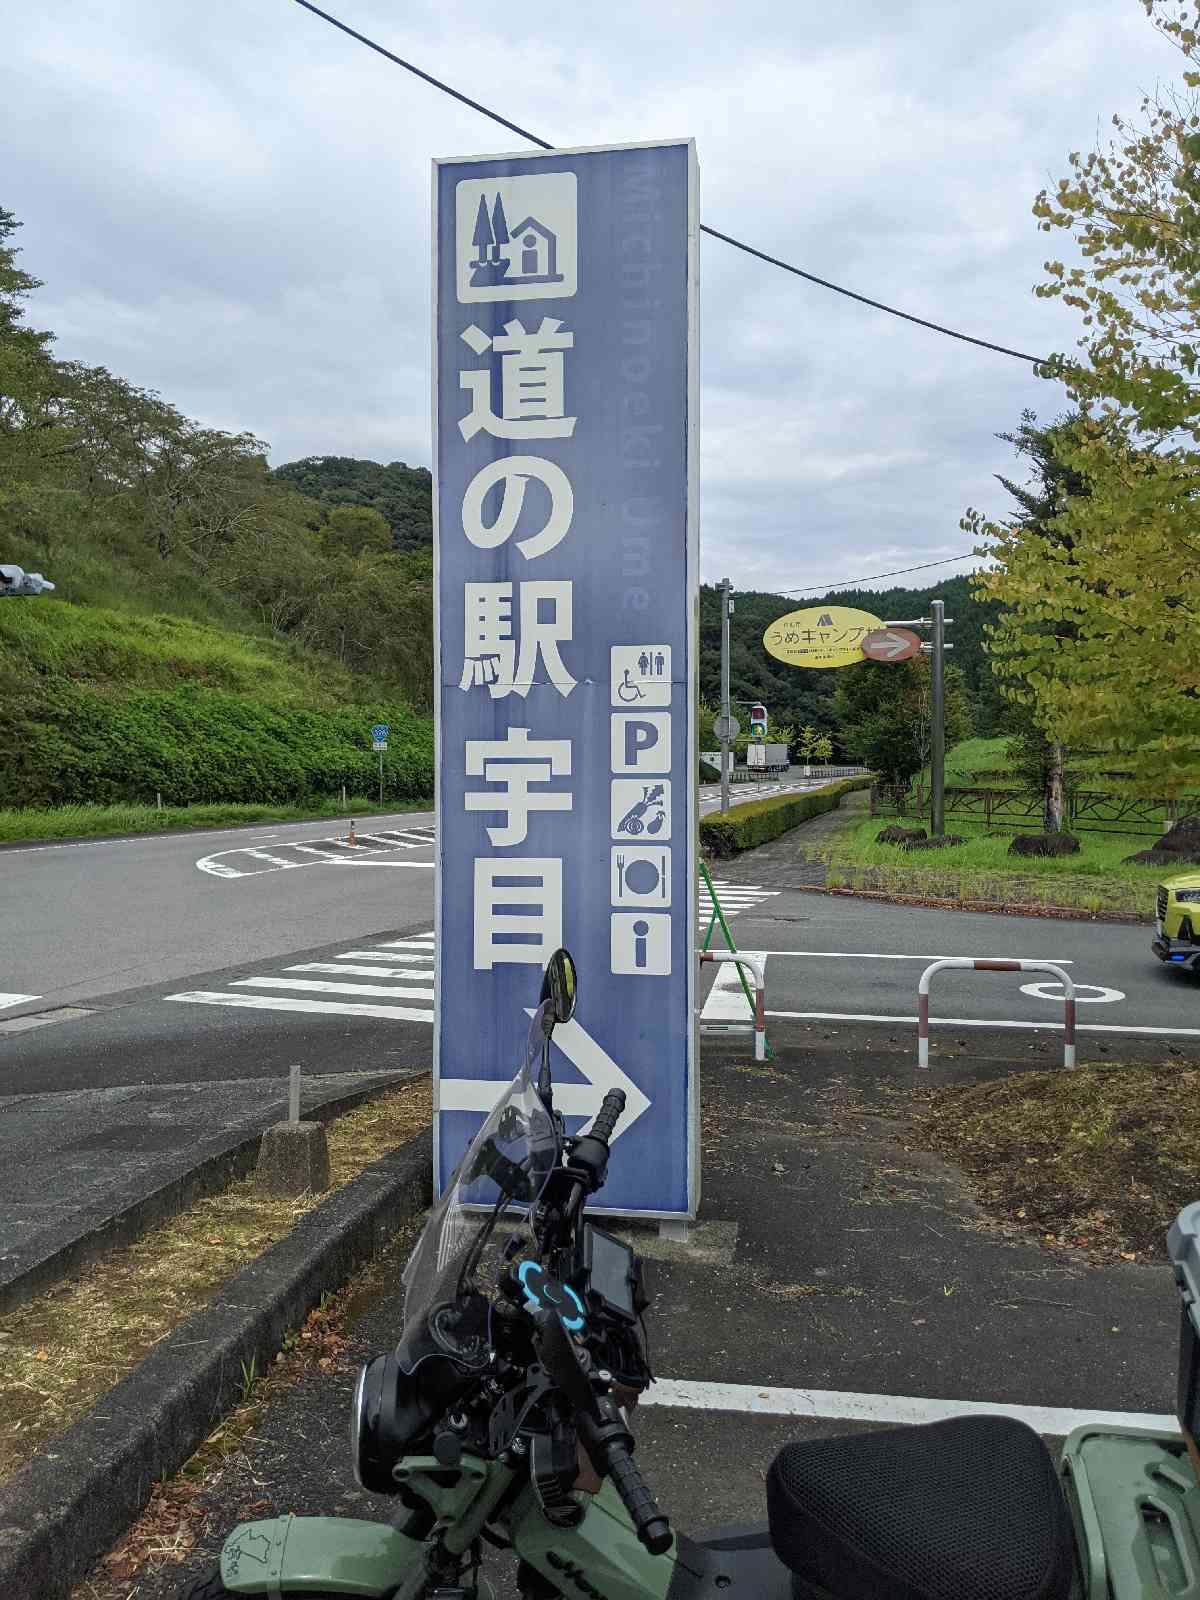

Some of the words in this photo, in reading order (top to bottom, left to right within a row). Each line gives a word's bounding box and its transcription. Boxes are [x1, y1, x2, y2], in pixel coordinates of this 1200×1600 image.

[458, 316, 578, 970] 道の駅宇目
[624, 720, 659, 766] P
